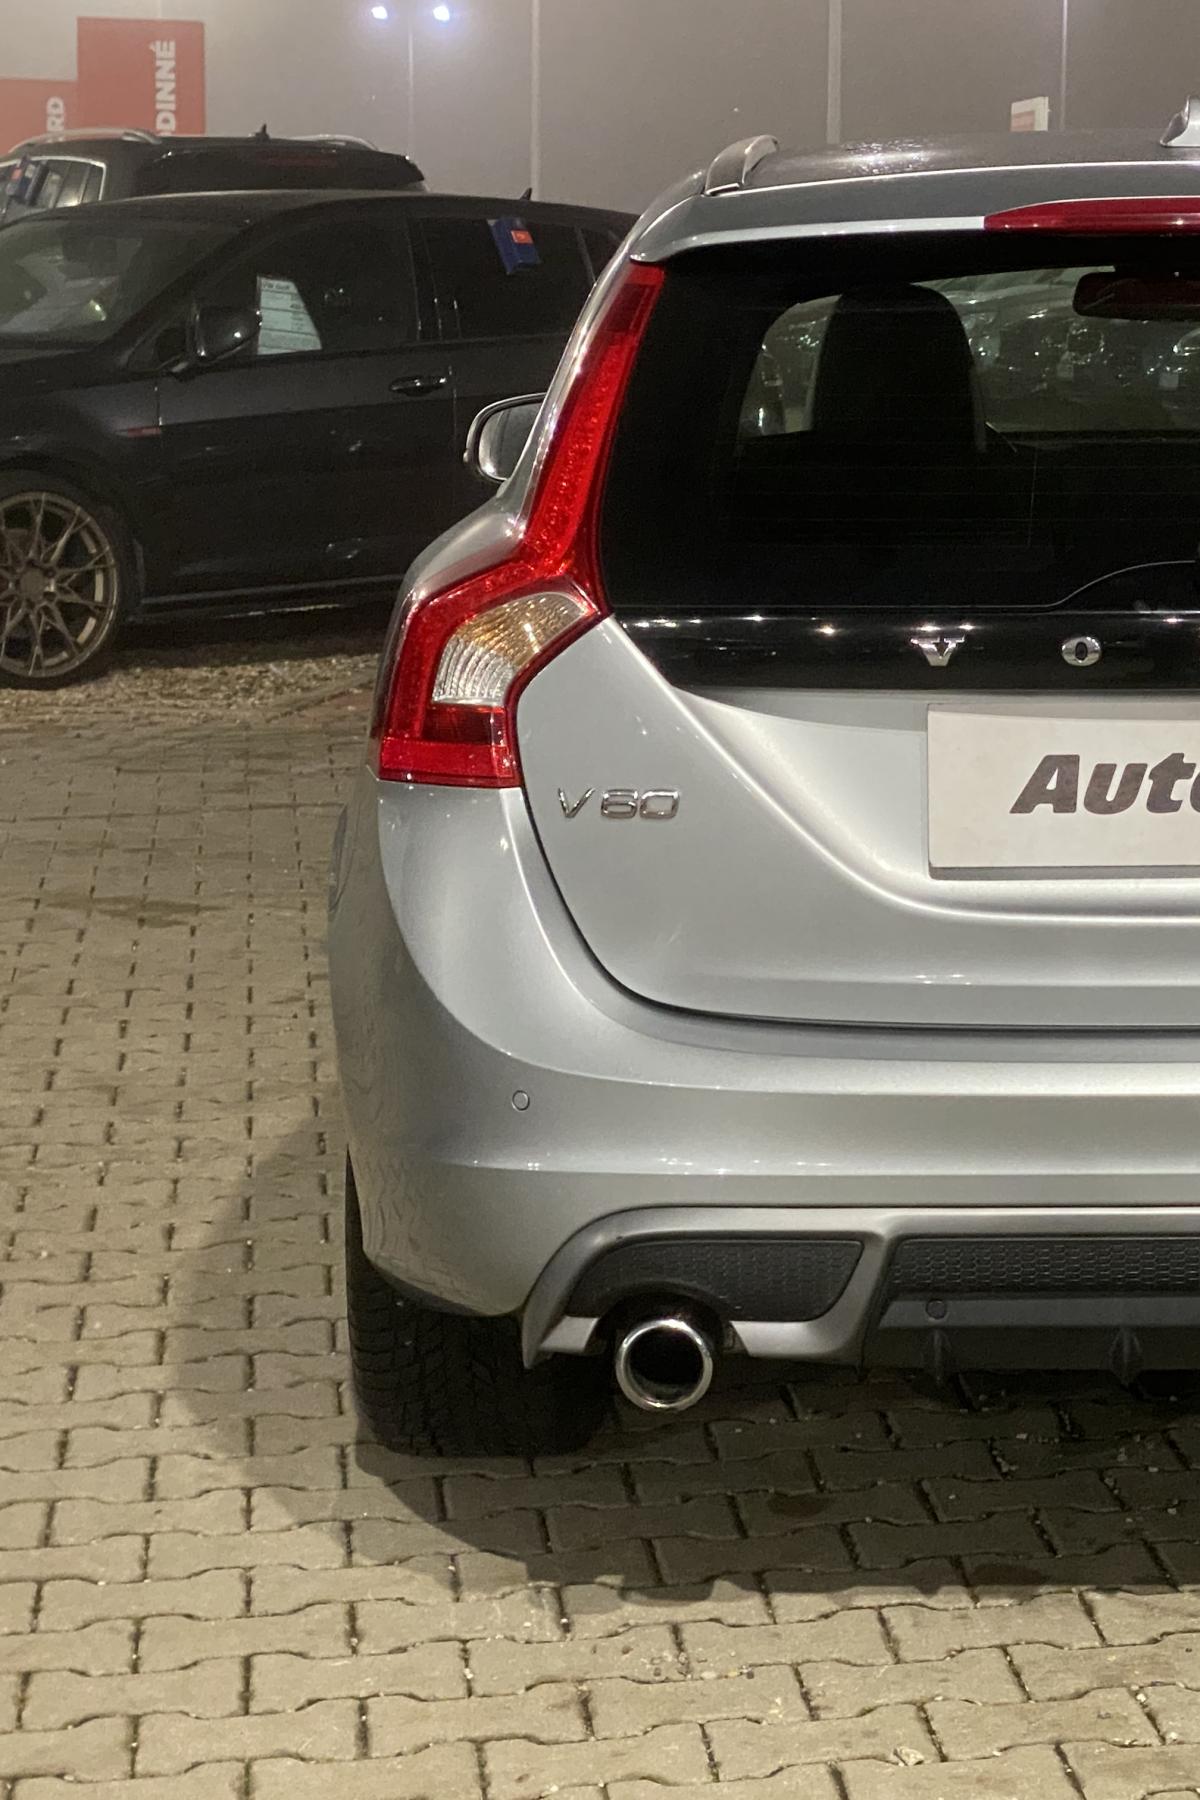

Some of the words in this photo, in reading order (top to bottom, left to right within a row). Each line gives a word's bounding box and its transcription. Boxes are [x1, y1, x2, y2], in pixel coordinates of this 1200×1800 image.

[150, 39, 176, 136] DINNÉ
[46, 96, 65, 142] RD
[557, 787, 680, 819] V60
